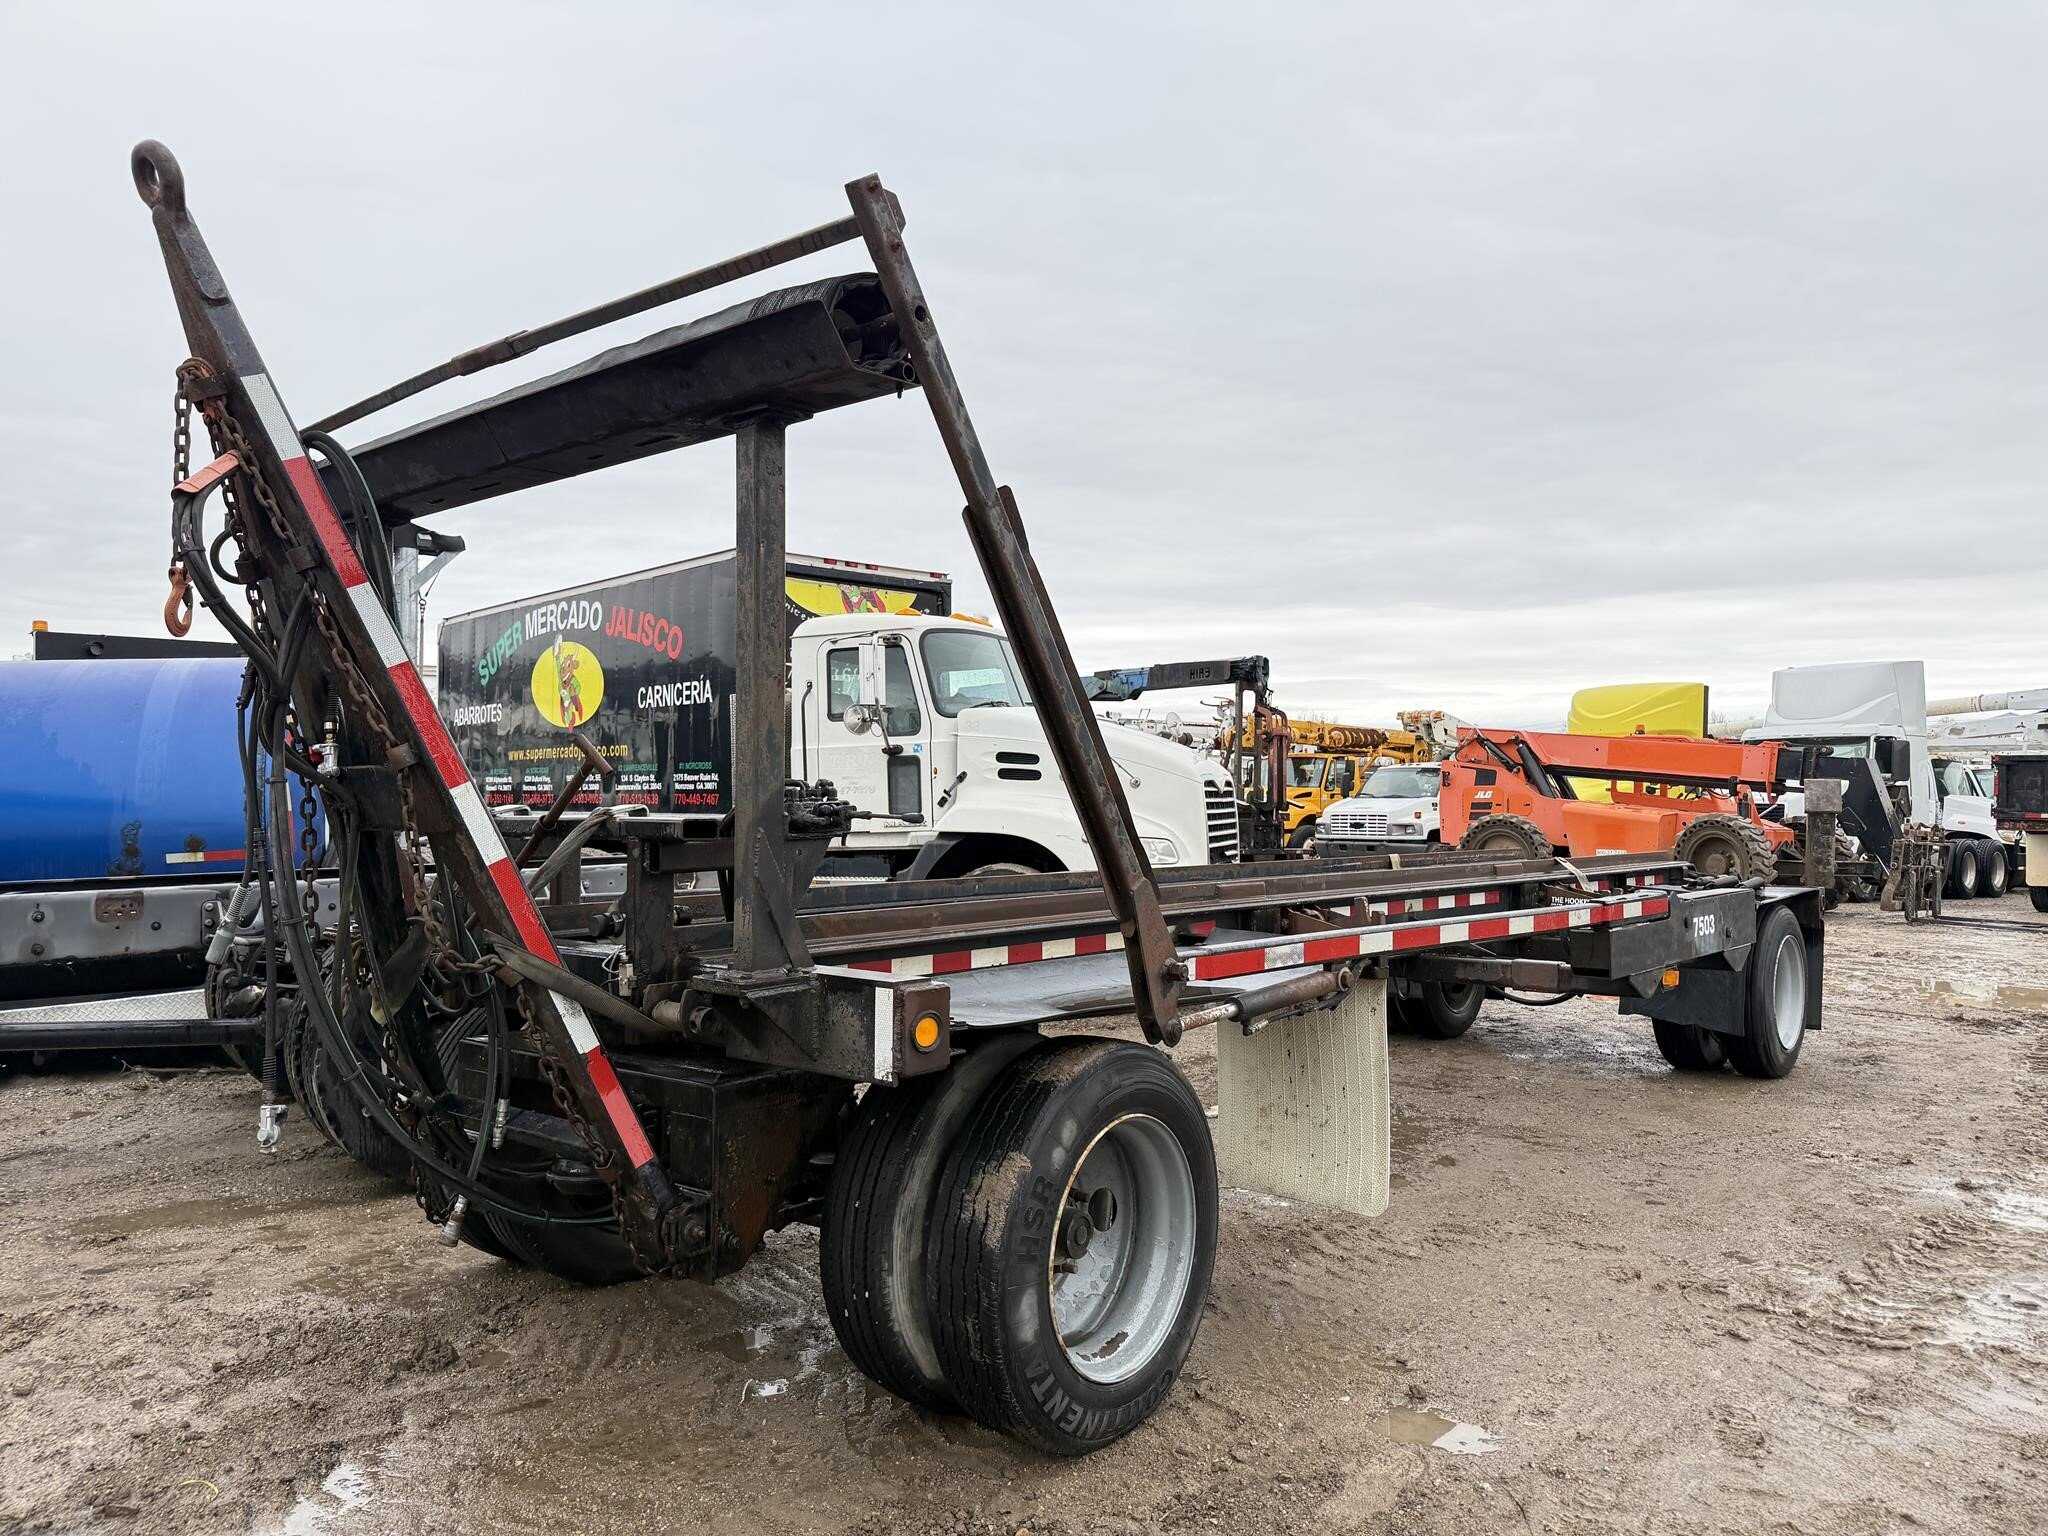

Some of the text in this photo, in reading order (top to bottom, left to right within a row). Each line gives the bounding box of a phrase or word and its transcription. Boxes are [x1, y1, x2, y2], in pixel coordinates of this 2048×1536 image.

[479, 601, 684, 686] SUPER MERCADO JALISCO
[638, 674, 713, 709] CARNICERÍA
[453, 703, 502, 727] ABARROTES
[1474, 790, 1493, 799] JLG
[1693, 914, 1715, 937] 7503
